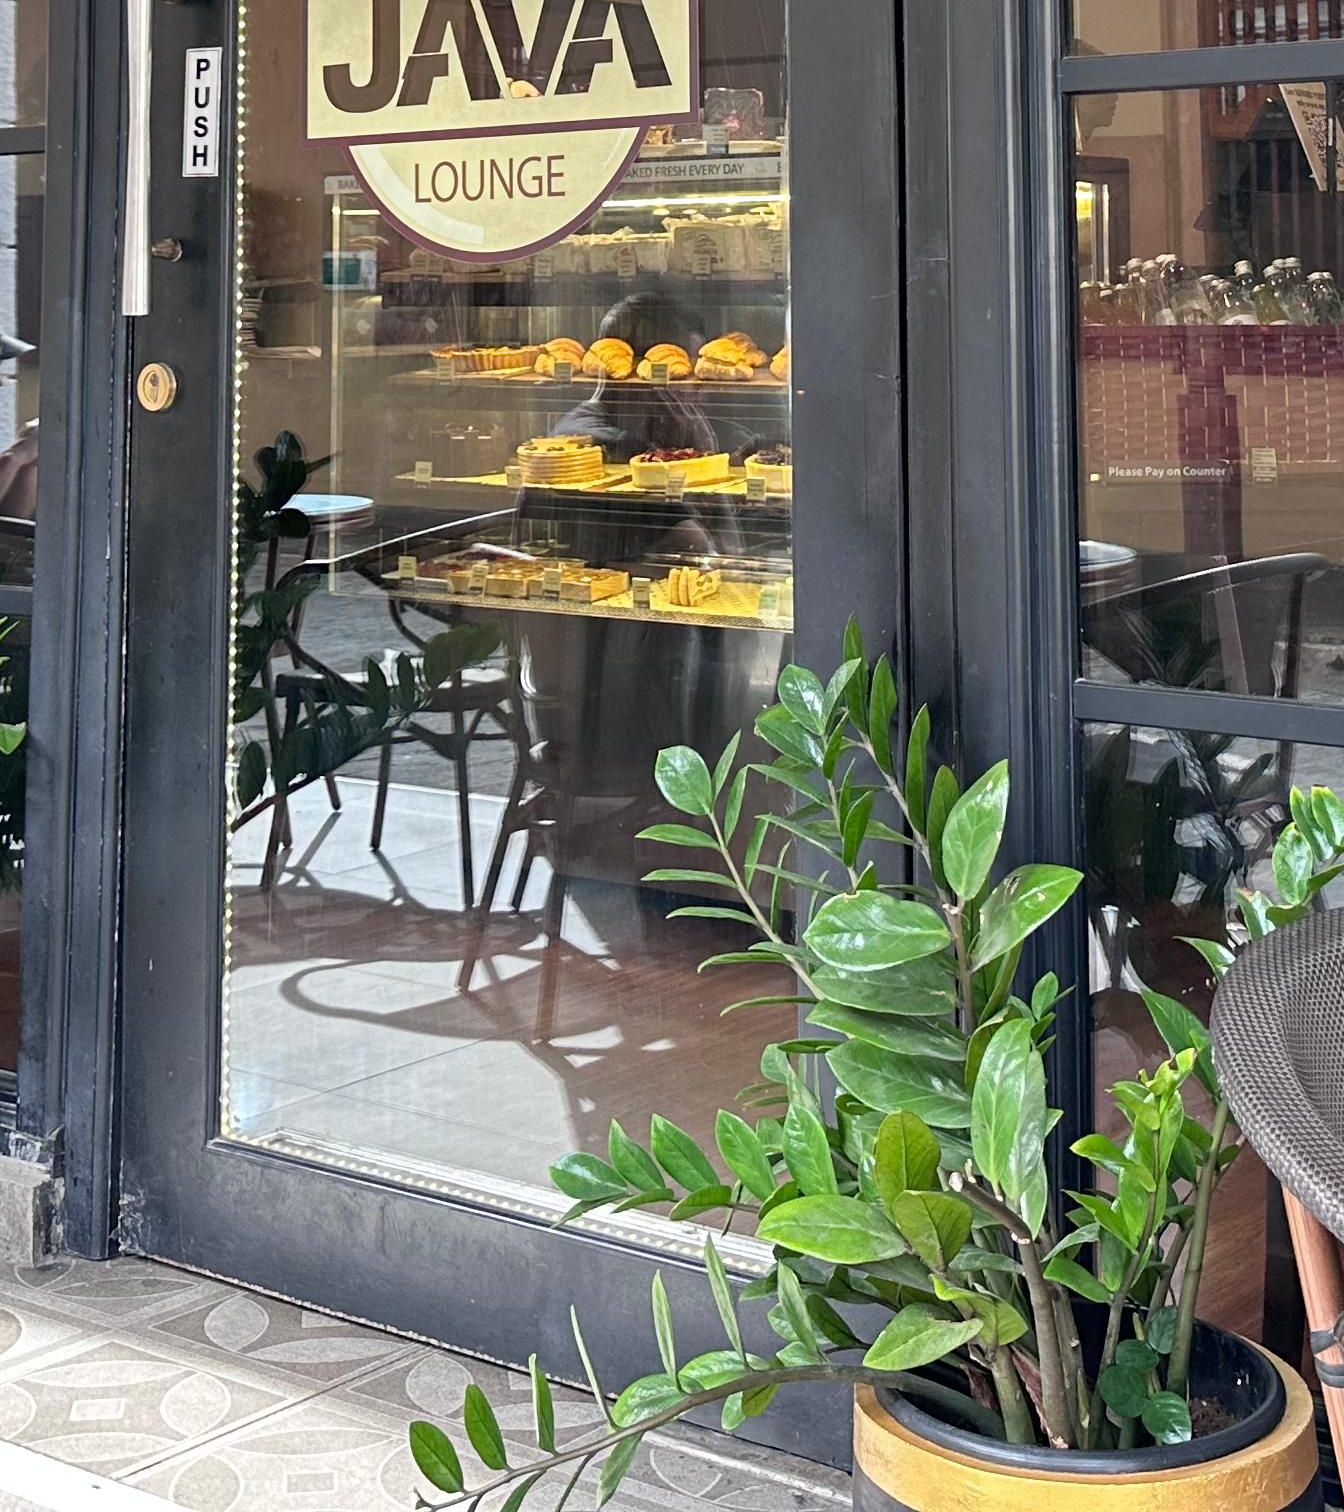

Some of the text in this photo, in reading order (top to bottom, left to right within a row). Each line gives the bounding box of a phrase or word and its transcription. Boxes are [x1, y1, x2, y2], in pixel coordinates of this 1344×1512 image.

[191, 57, 211, 169] PUSH
[414, 155, 566, 204] LOUNGE
[625, 162, 745, 179] AKED FRESH EVERY DAY
[1108, 465, 1226, 479] Please Pay on Counter
